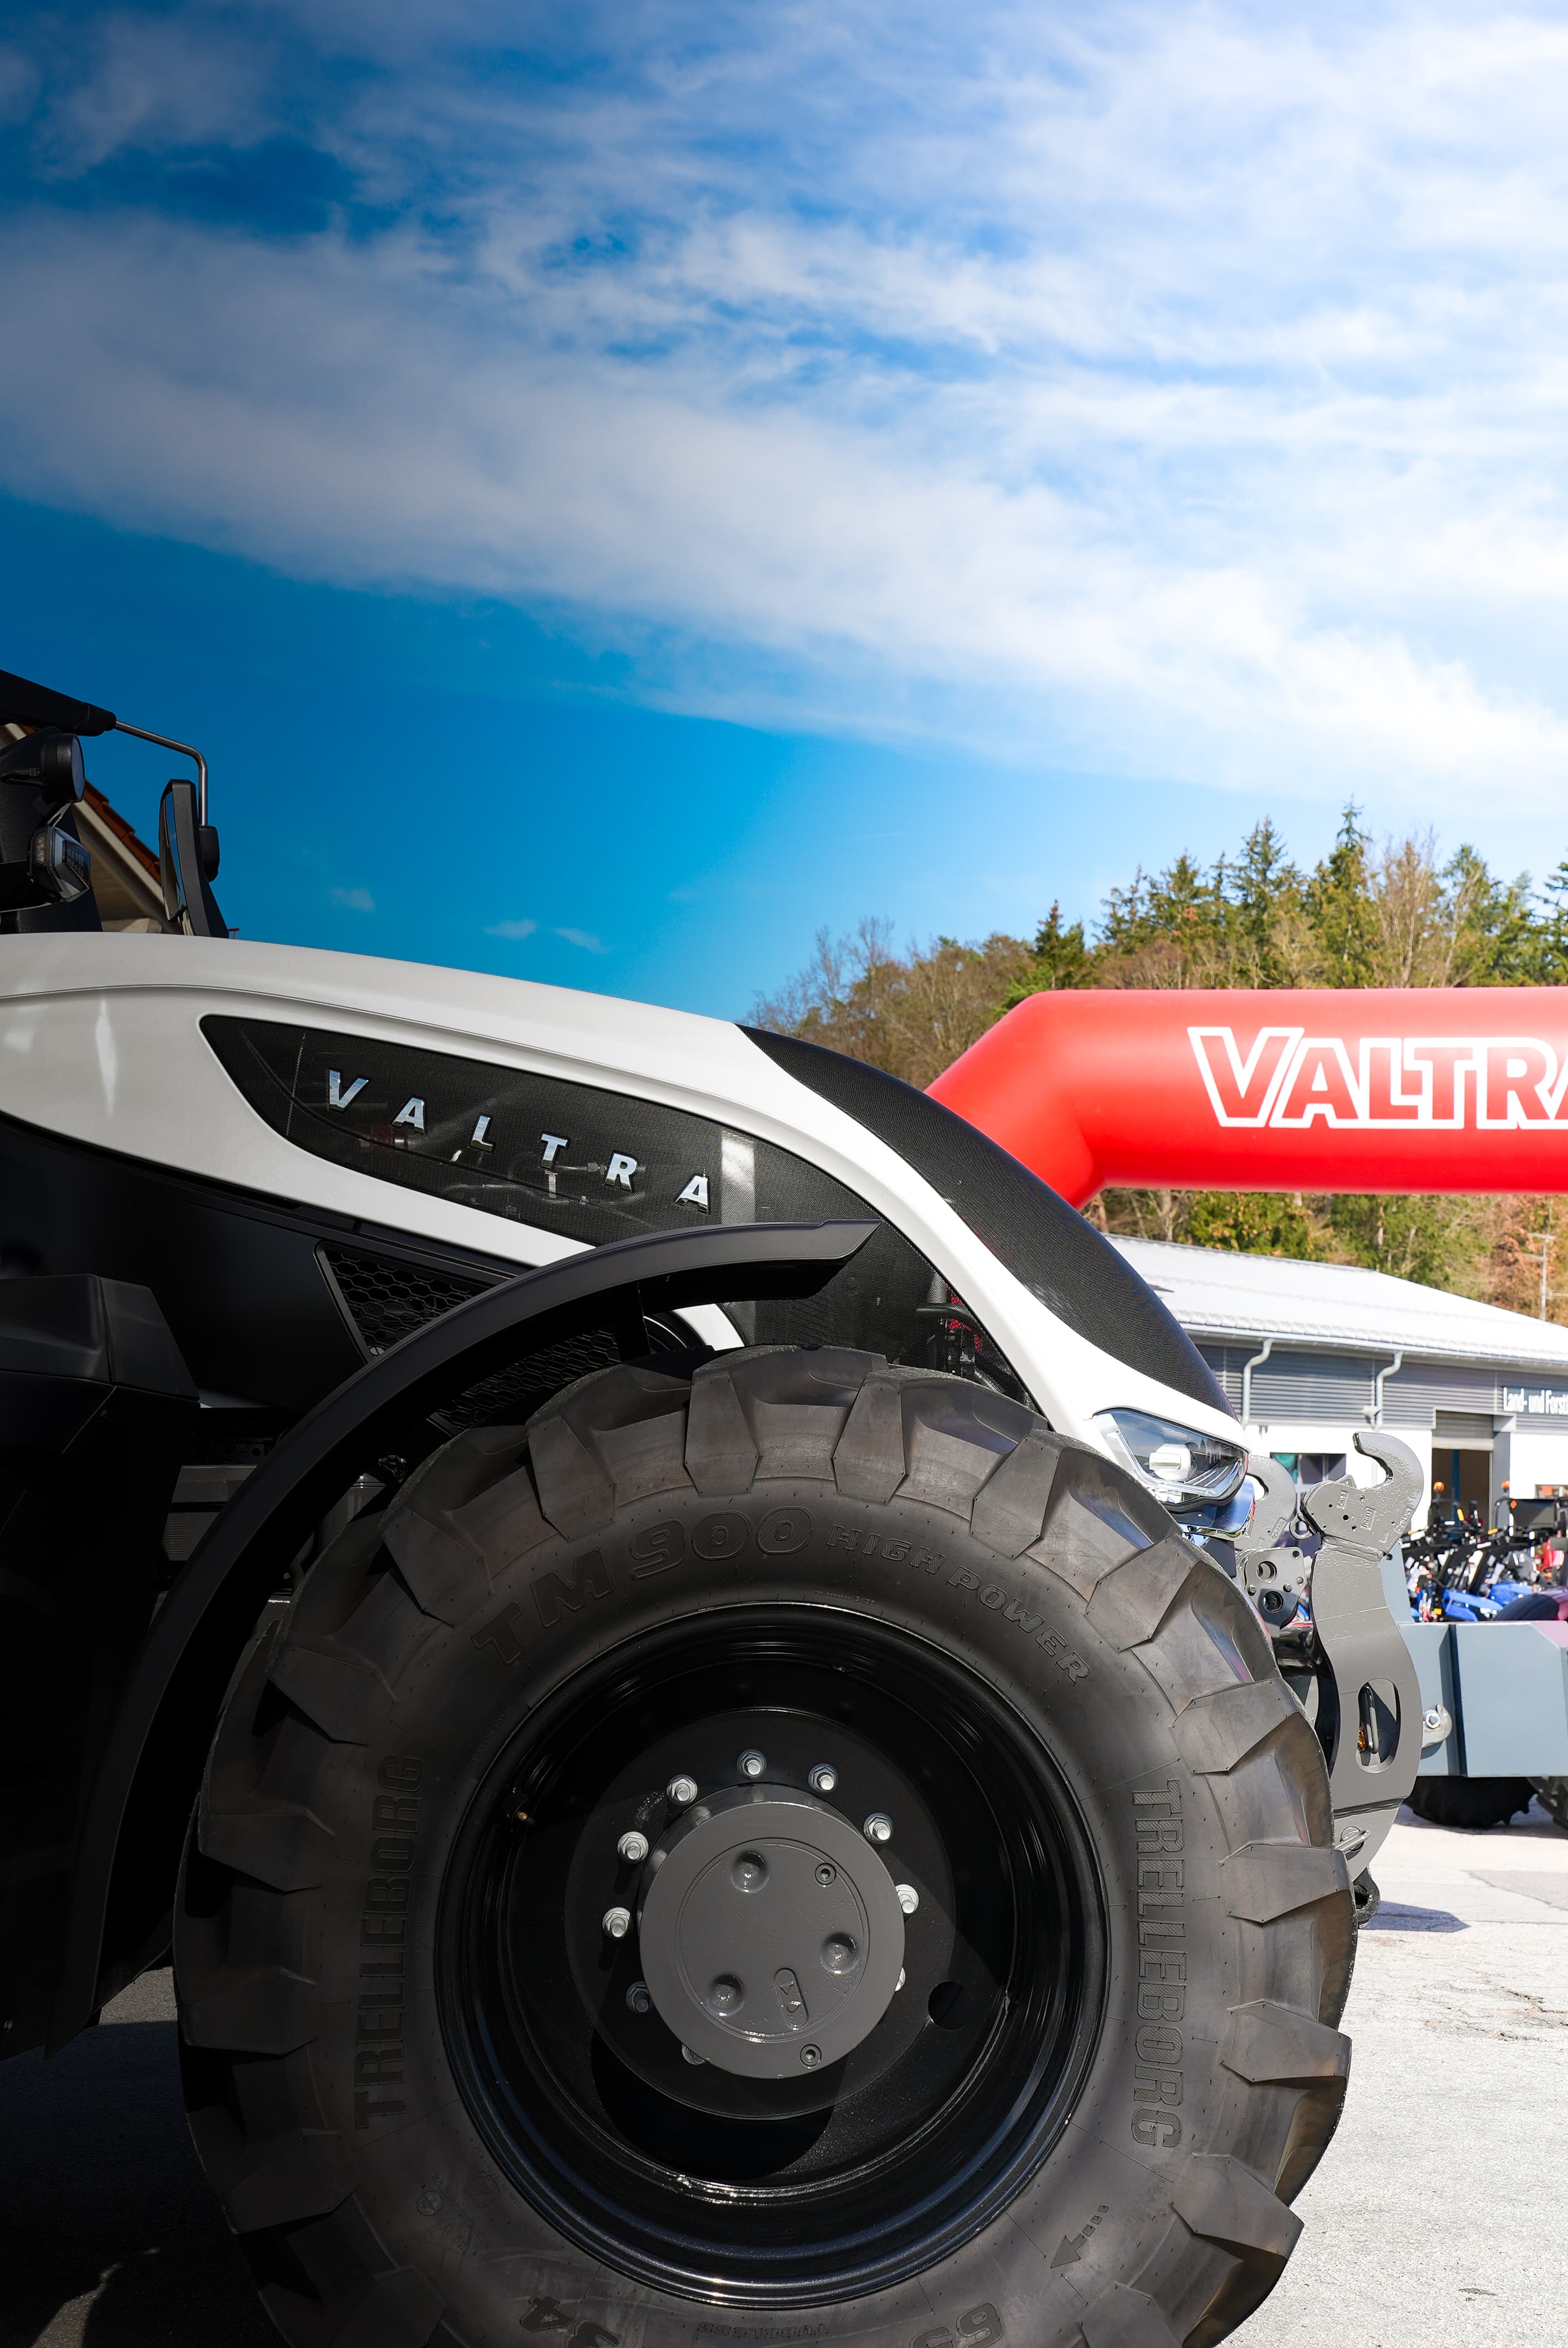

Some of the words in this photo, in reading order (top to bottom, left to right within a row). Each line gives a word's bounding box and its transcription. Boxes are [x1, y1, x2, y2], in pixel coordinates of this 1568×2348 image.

[328, 1069, 710, 1213] VALTRA
[1187, 1027, 1568, 1130] VALTR
[1503, 1387, 1528, 1413] Land-
[1528, 1389, 1544, 1414] und
[826, 1523, 947, 1575] HIGH
[947, 1565, 1091, 1686] POWER
[354, 1754, 425, 2129] TRELLEBORG
[1132, 1778, 1187, 2148] TRELLEBORG
[695, 2322, 828, 2340] TUBELESS
